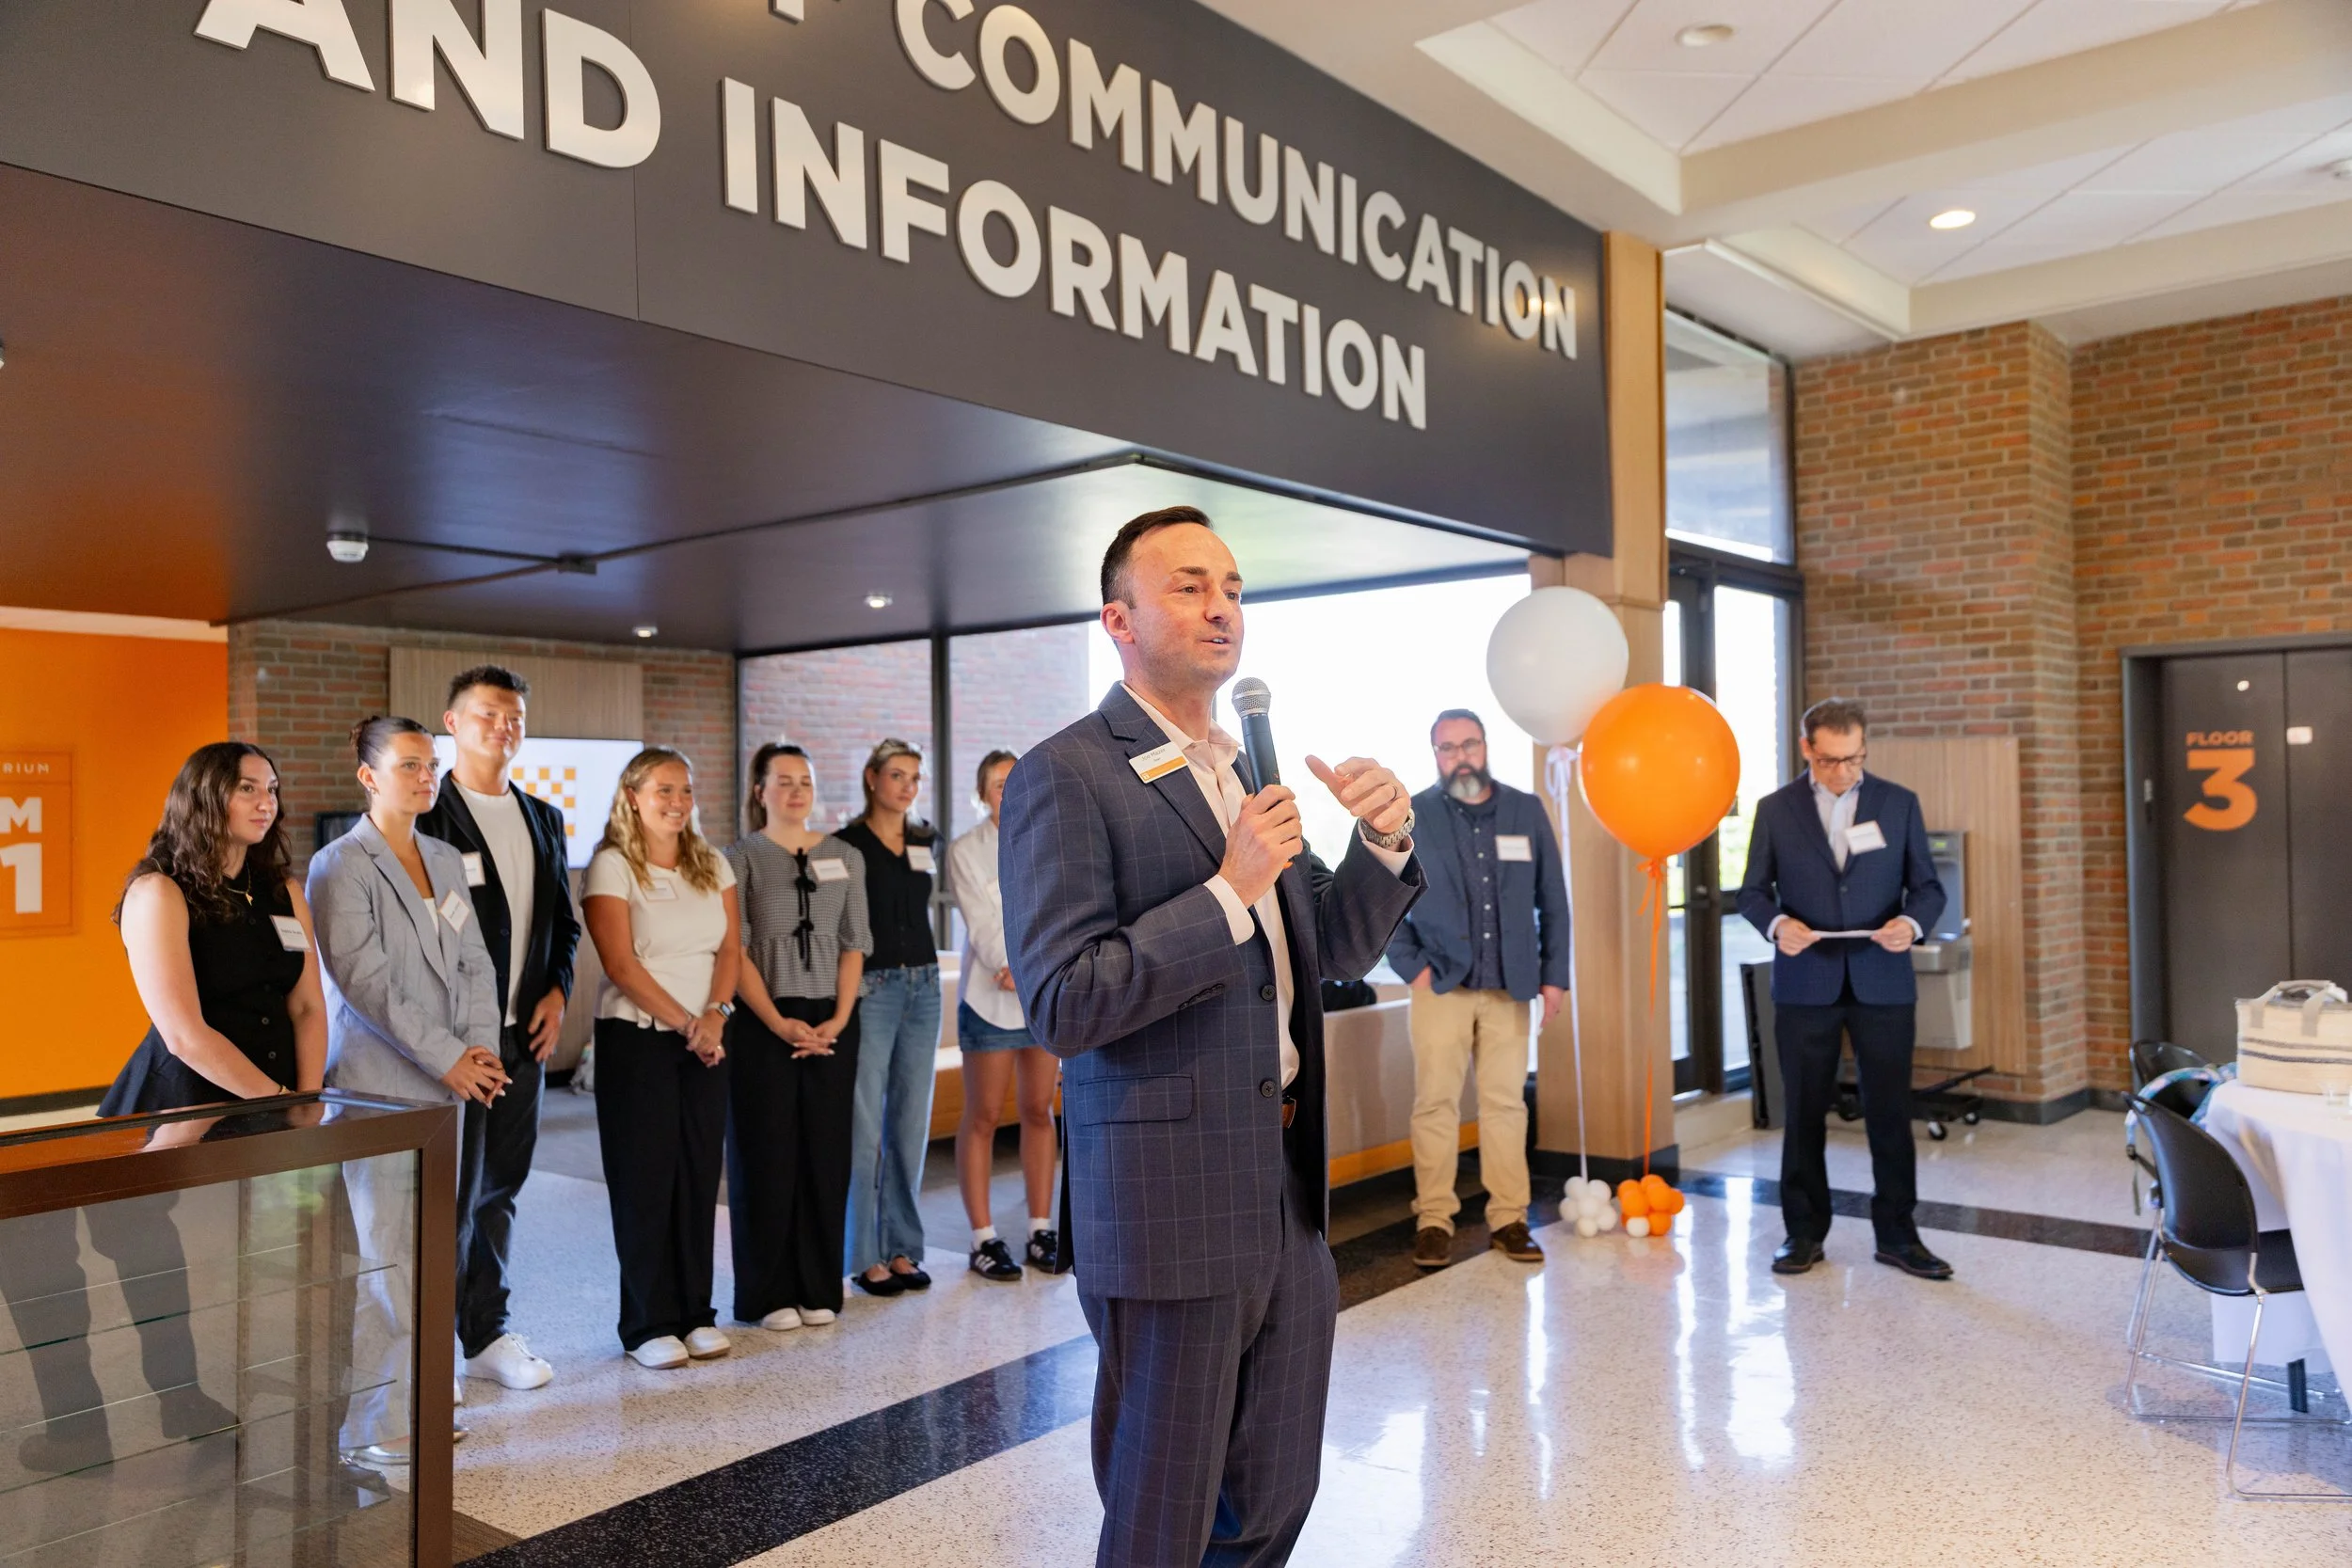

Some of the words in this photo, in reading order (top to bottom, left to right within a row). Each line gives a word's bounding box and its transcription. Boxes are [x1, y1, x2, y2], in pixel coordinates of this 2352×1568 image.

[721, 75, 1427, 430] INFORMATION
[895, 0, 1578, 359] COMMUNICATION
[2183, 749, 2258, 832] 3
[2185, 730, 2254, 746] FLOOR
